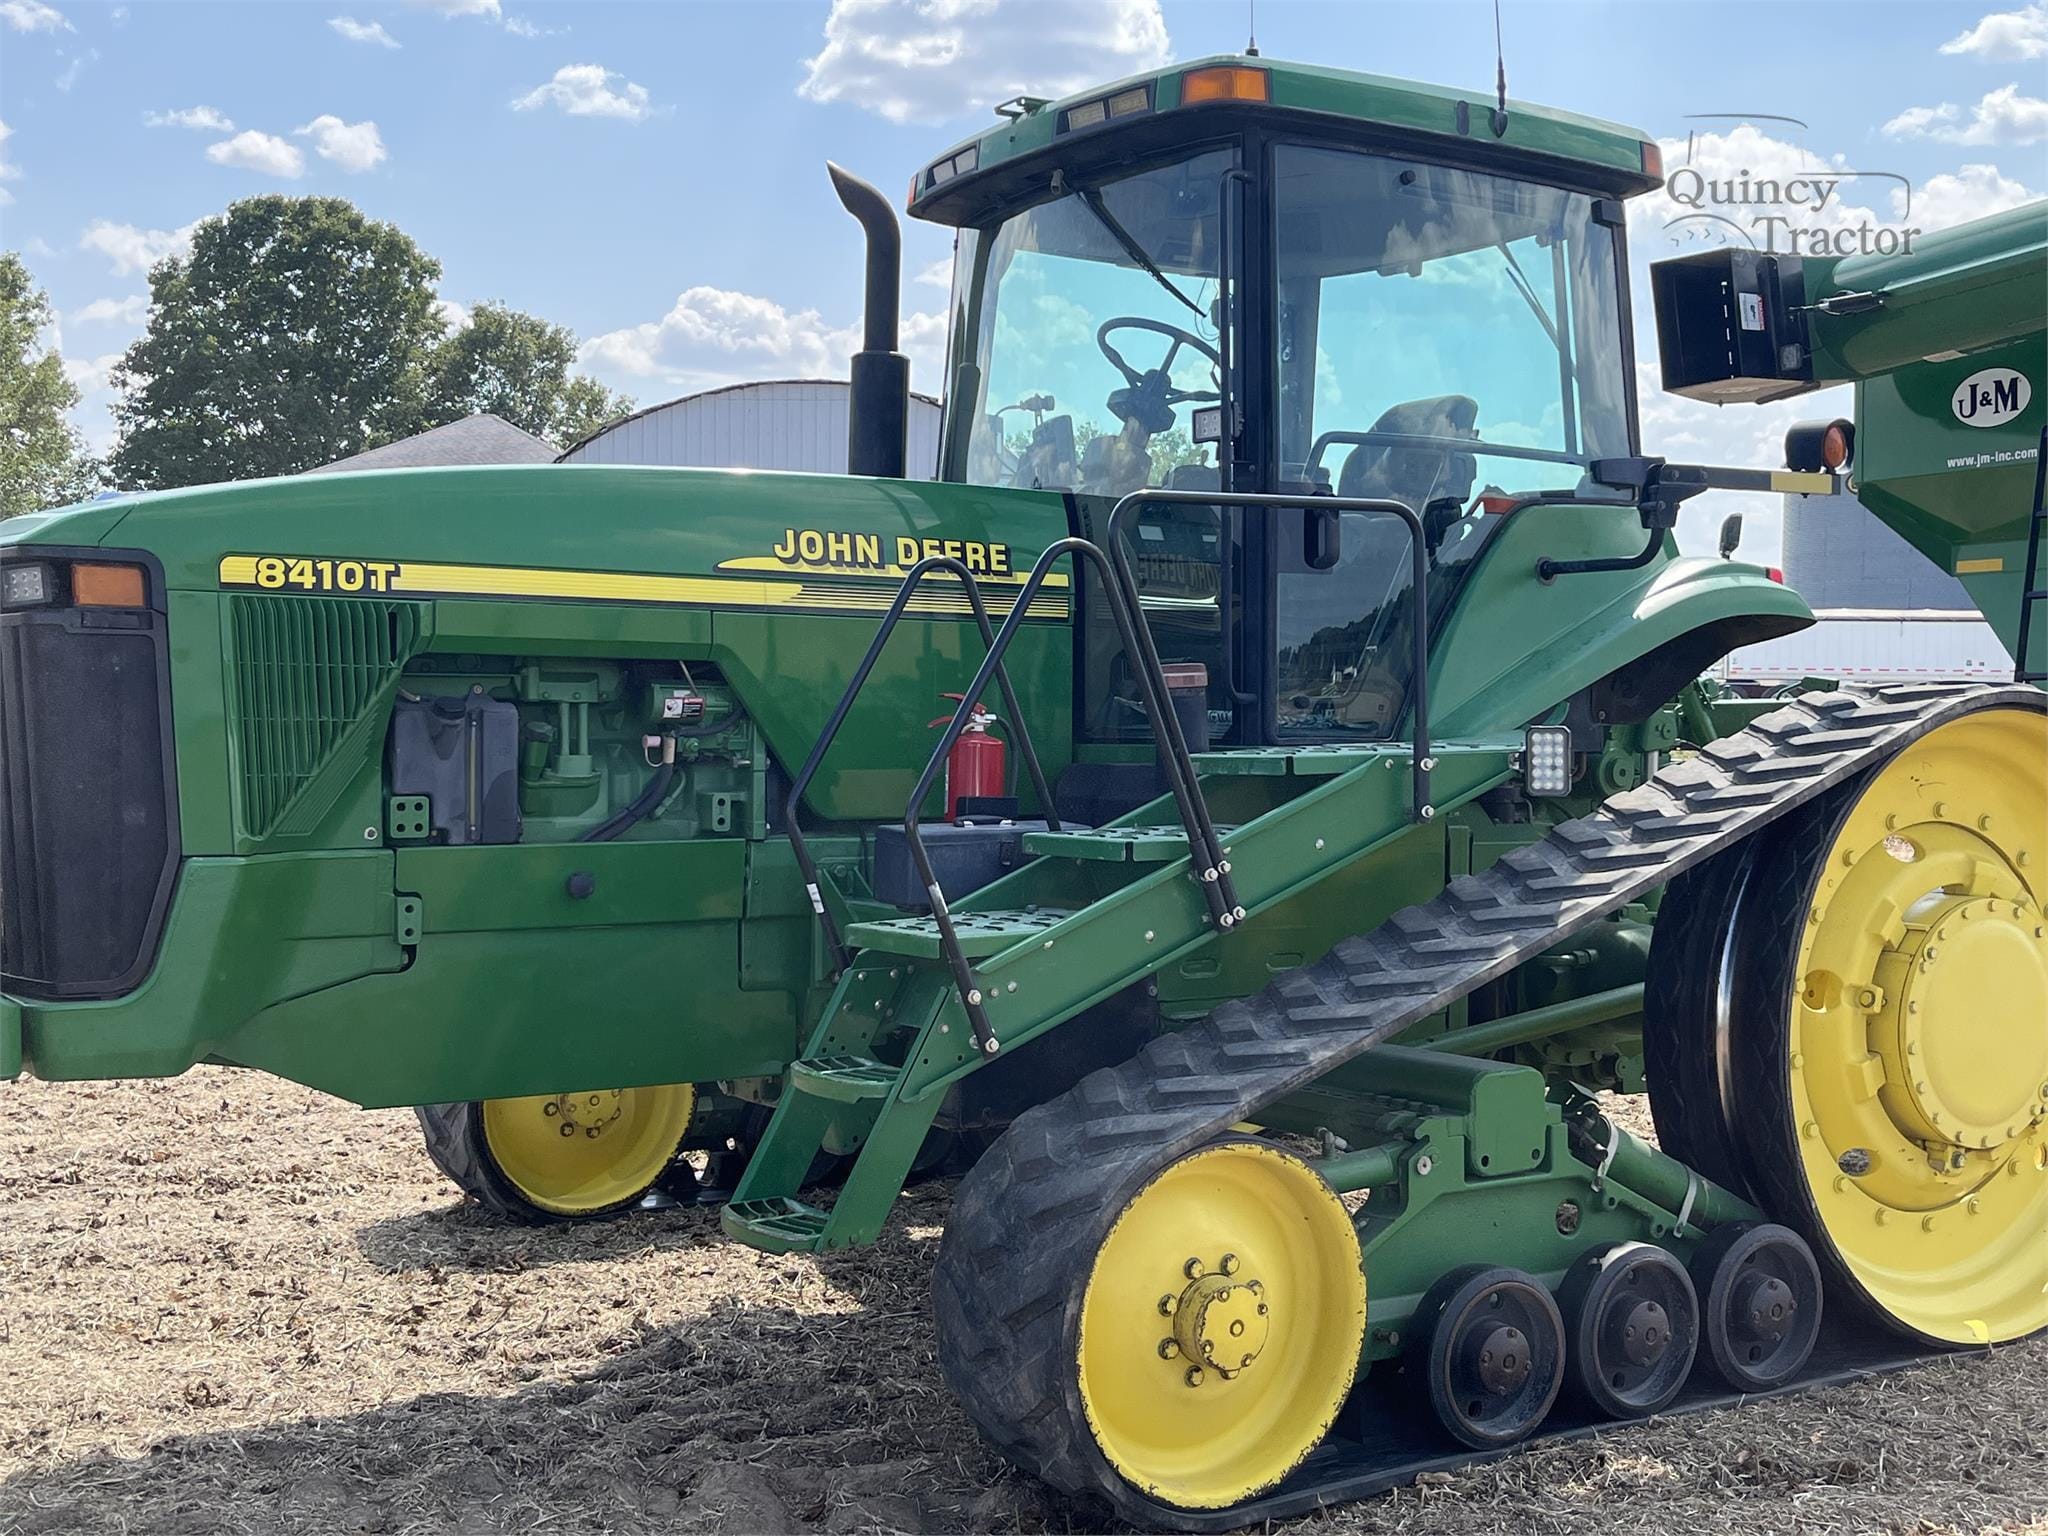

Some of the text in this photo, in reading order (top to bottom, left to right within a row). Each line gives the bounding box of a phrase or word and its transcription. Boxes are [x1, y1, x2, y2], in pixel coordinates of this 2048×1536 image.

[1958, 374, 2020, 419] J&M
[1947, 448, 2038, 468] www.jm-inc.com
[773, 528, 1010, 572] JOHN DEERE
[256, 557, 397, 593] 8410T
